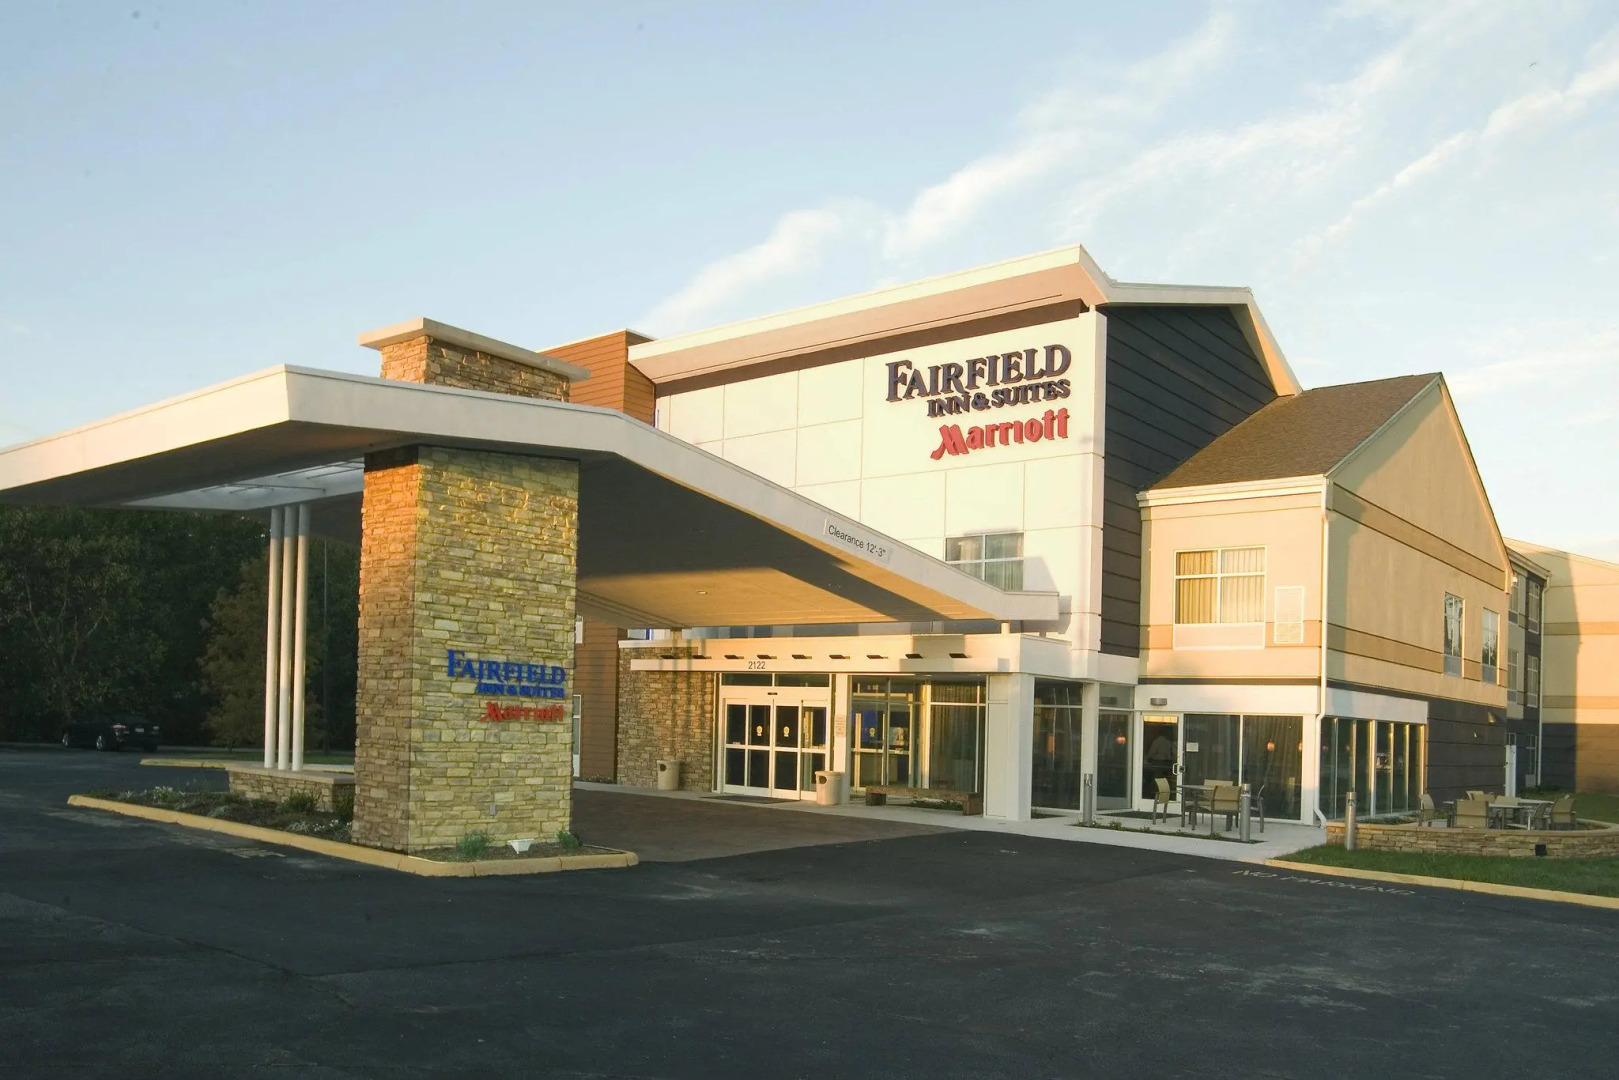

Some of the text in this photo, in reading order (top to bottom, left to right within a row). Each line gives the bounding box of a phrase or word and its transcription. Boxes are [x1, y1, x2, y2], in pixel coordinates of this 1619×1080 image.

[885, 344, 1072, 402] FAIRFIELD
[930, 407, 1069, 460] Marriott
[828, 525, 864, 548] Clearance
[447, 649, 566, 684] FAIRFIELD
[748, 661, 766, 669] 2122
[480, 701, 564, 722] Marriott
